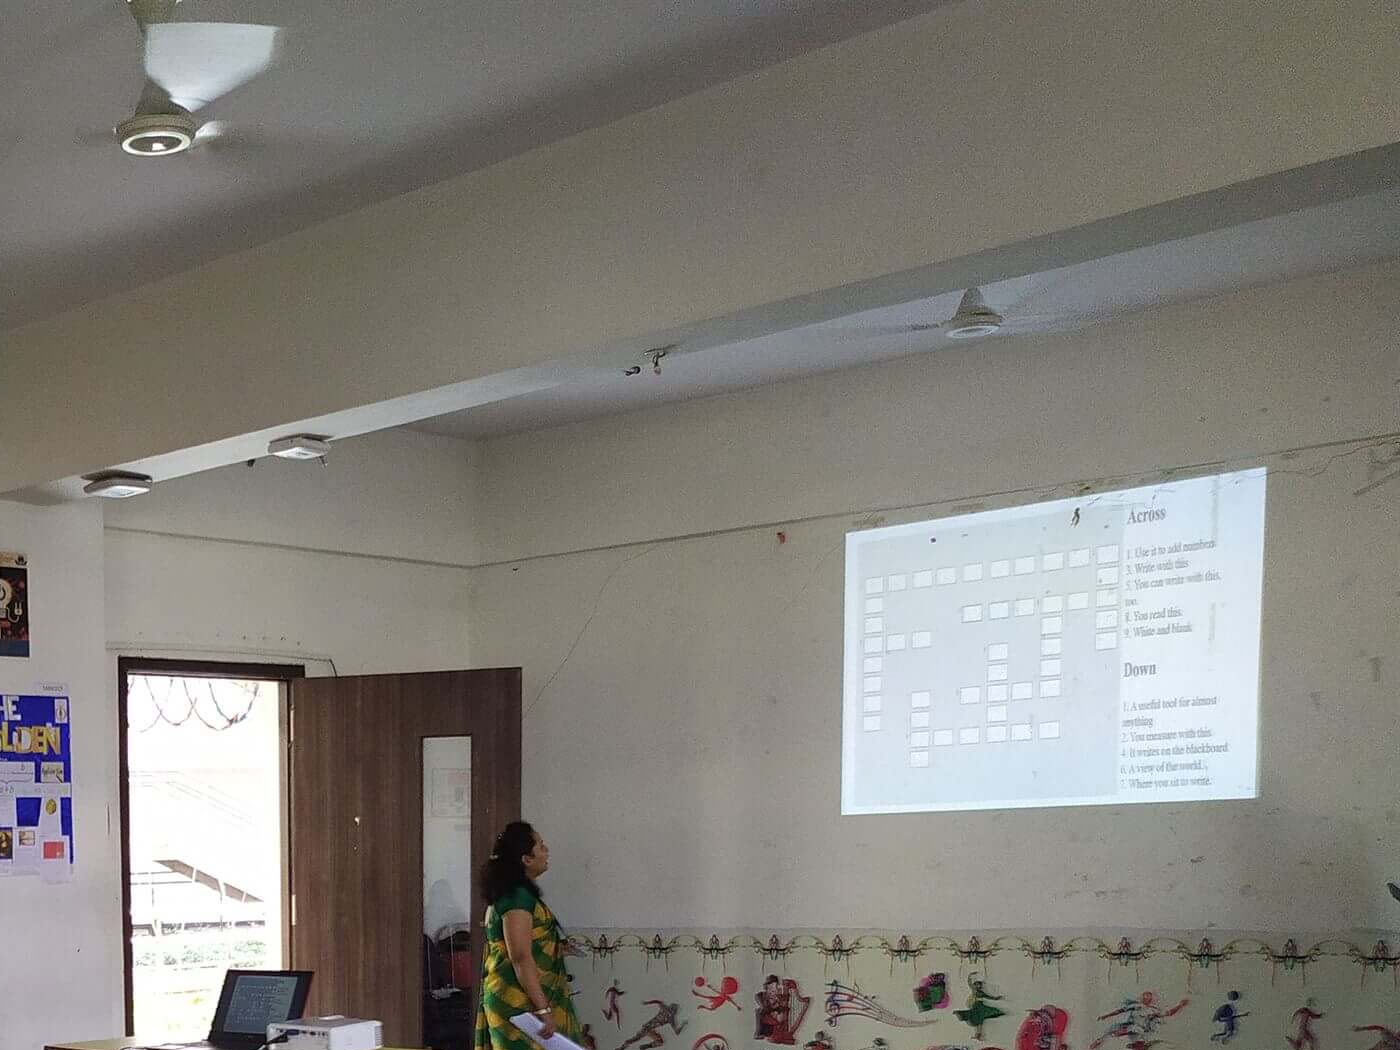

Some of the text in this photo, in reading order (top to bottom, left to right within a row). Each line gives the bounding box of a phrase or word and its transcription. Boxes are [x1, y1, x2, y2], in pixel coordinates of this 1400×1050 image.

[1127, 508, 1167, 525] Across
[1135, 547, 1149, 558] Use
[1150, 546, 1157, 556] it
[1158, 546, 1166, 555] to
[1167, 542, 1182, 554] add
[1135, 562, 1155, 574] Write
[1156, 560, 1173, 571] with
[1135, 579, 1149, 590] You
[1150, 579, 1163, 588] can
[1165, 576, 1184, 586] write
[1134, 610, 1149, 621] You
[1150, 608, 1166, 619] read
[1156, 624, 1171, 635] and
[1123, 662, 1156, 677] Down
[1130, 701, 1137, 711] A
[1138, 699, 1160, 710] useful
[1162, 698, 1177, 708] tool
[1178, 697, 1190, 707] for
[1191, 696, 1217, 706] almost
[1130, 731, 1144, 741] You
[1146, 731, 1177, 741] measure
[1178, 729, 1195, 738] with
[1137, 747, 1160, 757] writes
[1161, 748, 1171, 756] on
[1172, 745, 1184, 755] the
[1137, 763, 1154, 774] view
[1155, 761, 1165, 772] of
[1166, 761, 1178, 772] the
[1129, 778, 1153, 789] Where
